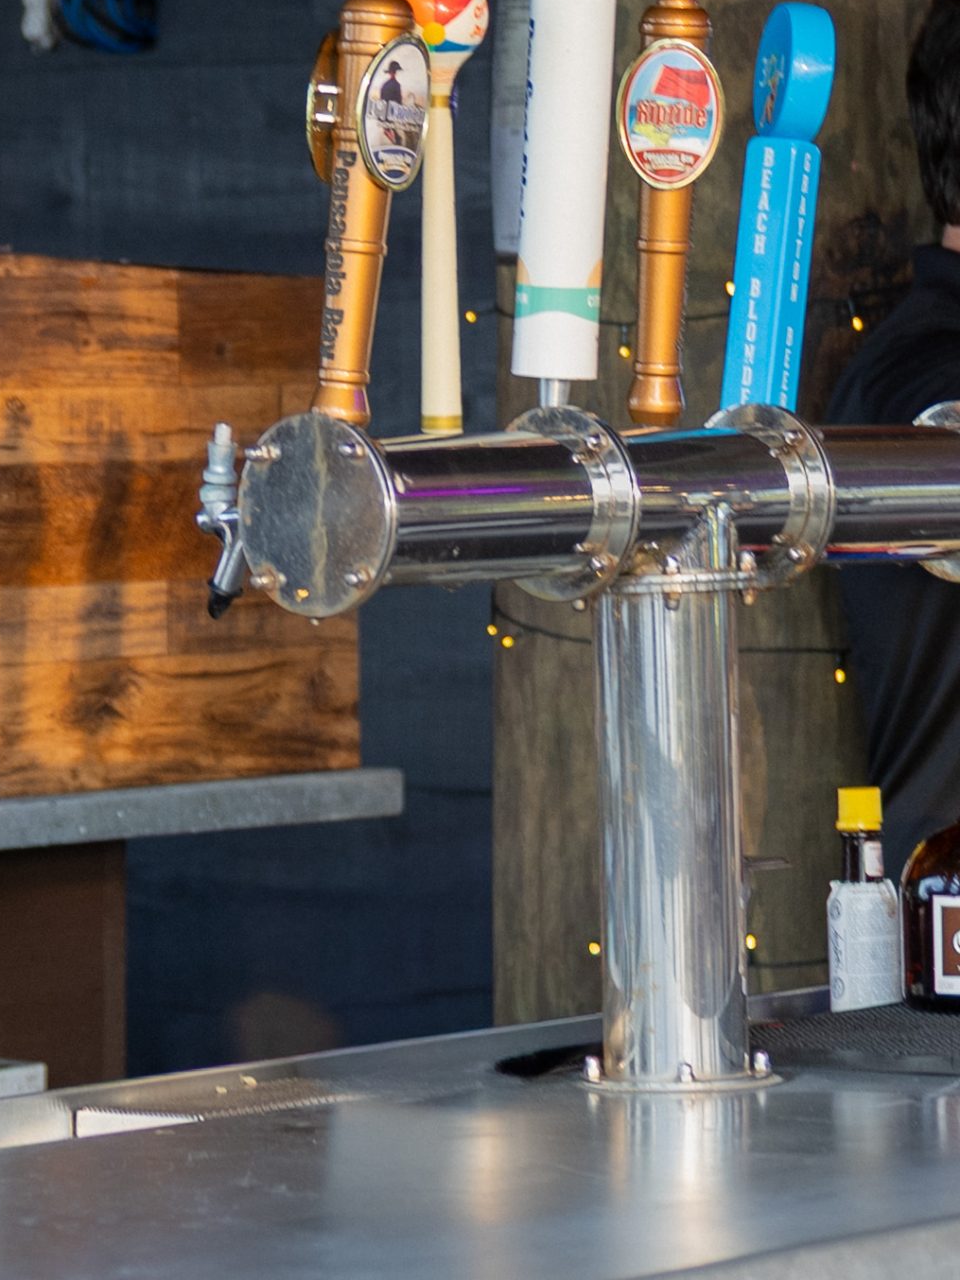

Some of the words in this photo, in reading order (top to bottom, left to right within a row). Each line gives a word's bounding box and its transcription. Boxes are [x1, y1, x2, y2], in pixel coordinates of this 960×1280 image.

[326, 150, 357, 296] Pensacola
[753, 146, 776, 256] BEACH
[790, 152, 811, 303] GRAYTON
[740, 276, 762, 405] BLONDE
[779, 326, 794, 408] BEER
